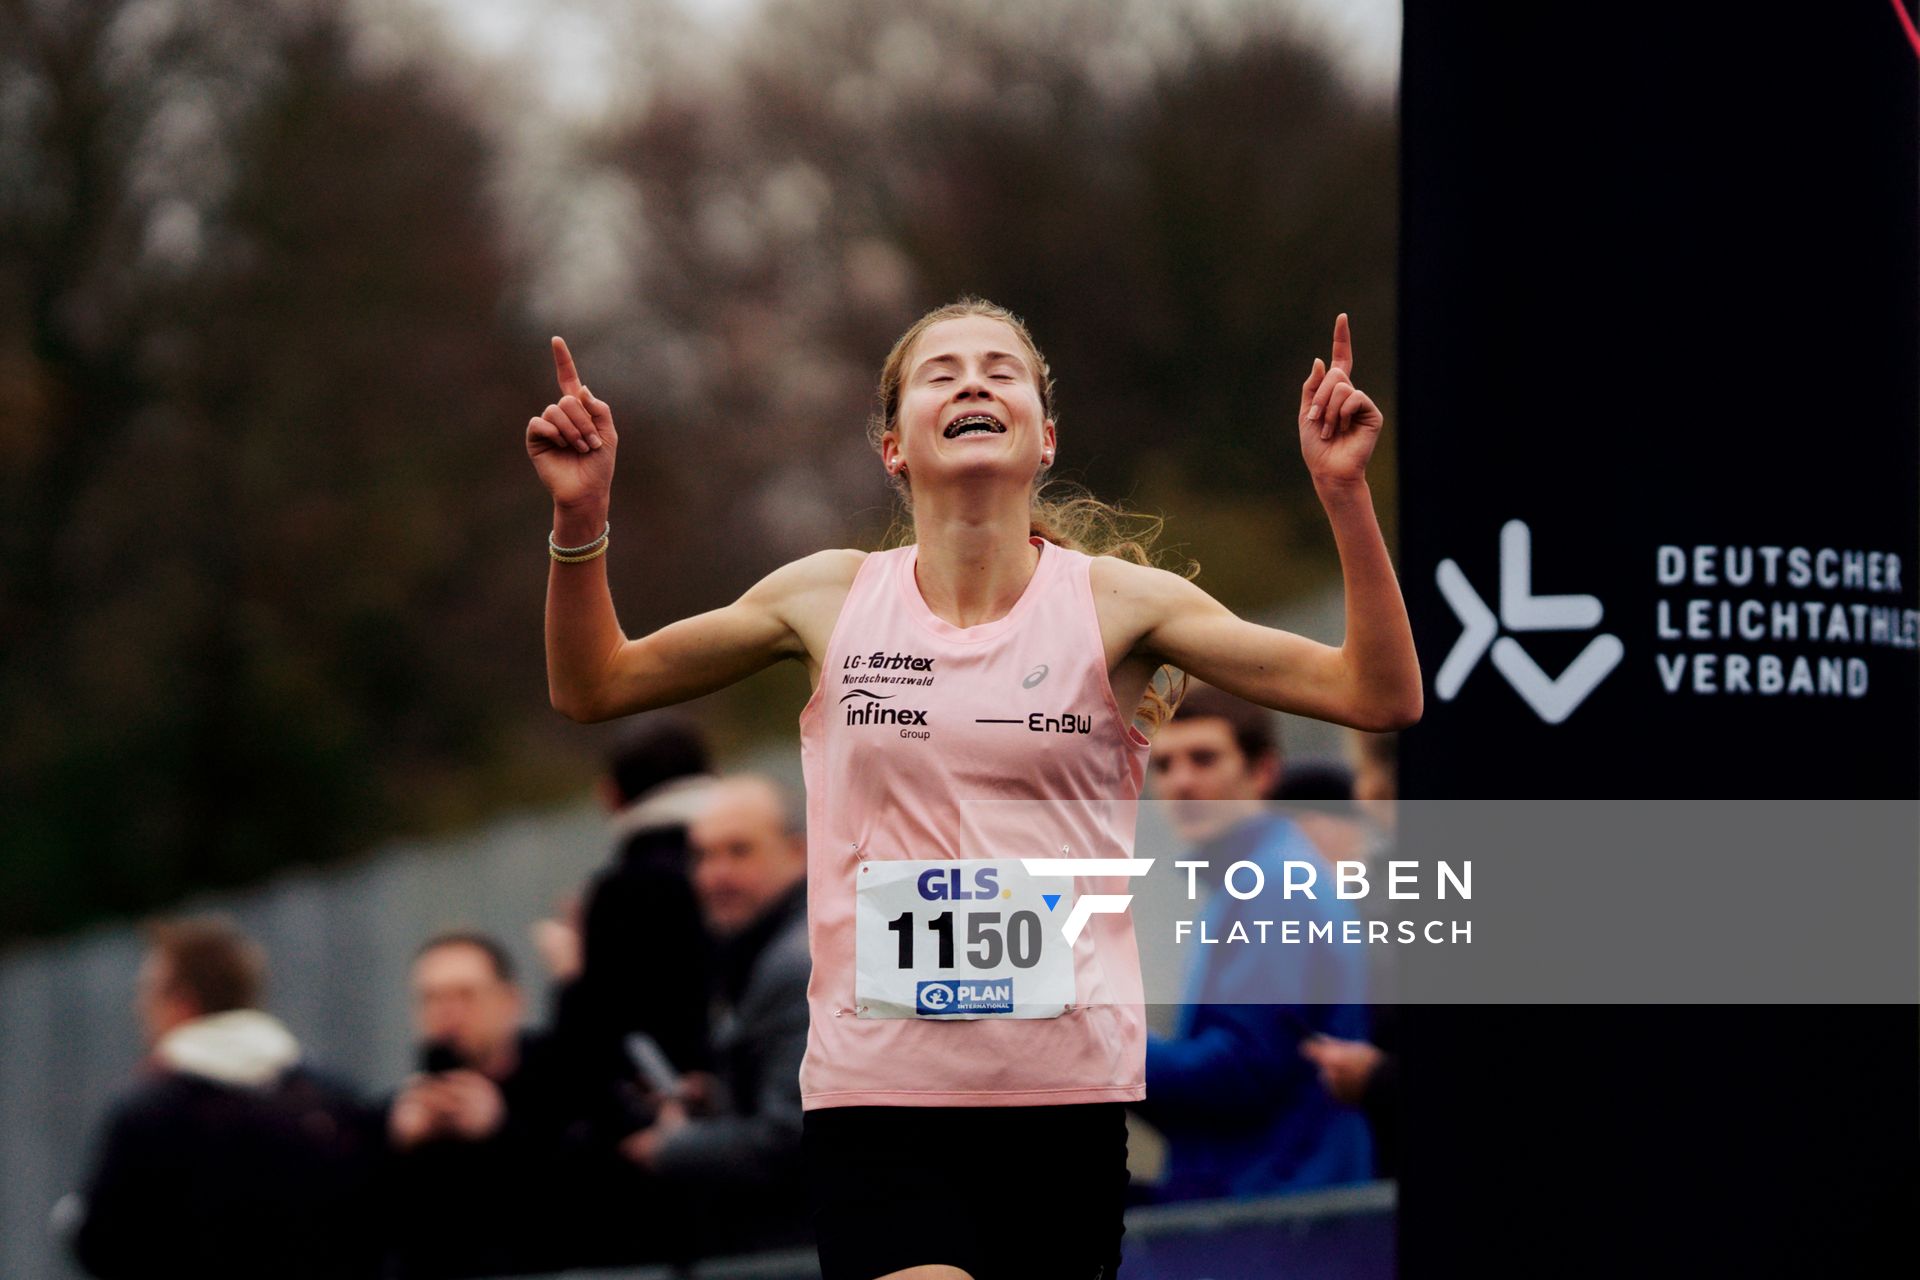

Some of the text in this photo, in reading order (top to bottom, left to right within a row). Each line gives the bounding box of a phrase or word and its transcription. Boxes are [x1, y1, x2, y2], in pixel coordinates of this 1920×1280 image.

[1657, 545, 1903, 591] DEUTSCHER
[842, 673, 935, 687] Nordschwarzwald
[1656, 653, 1869, 698] VERBAND
[846, 701, 928, 726] infinex
[1028, 712, 1092, 734] EnBW
[899, 728, 931, 740] Group
[888, 910, 1043, 970] 1150
[957, 985, 1010, 1001] PLAN
[957, 1002, 1010, 1010] INTERNATIONAL
